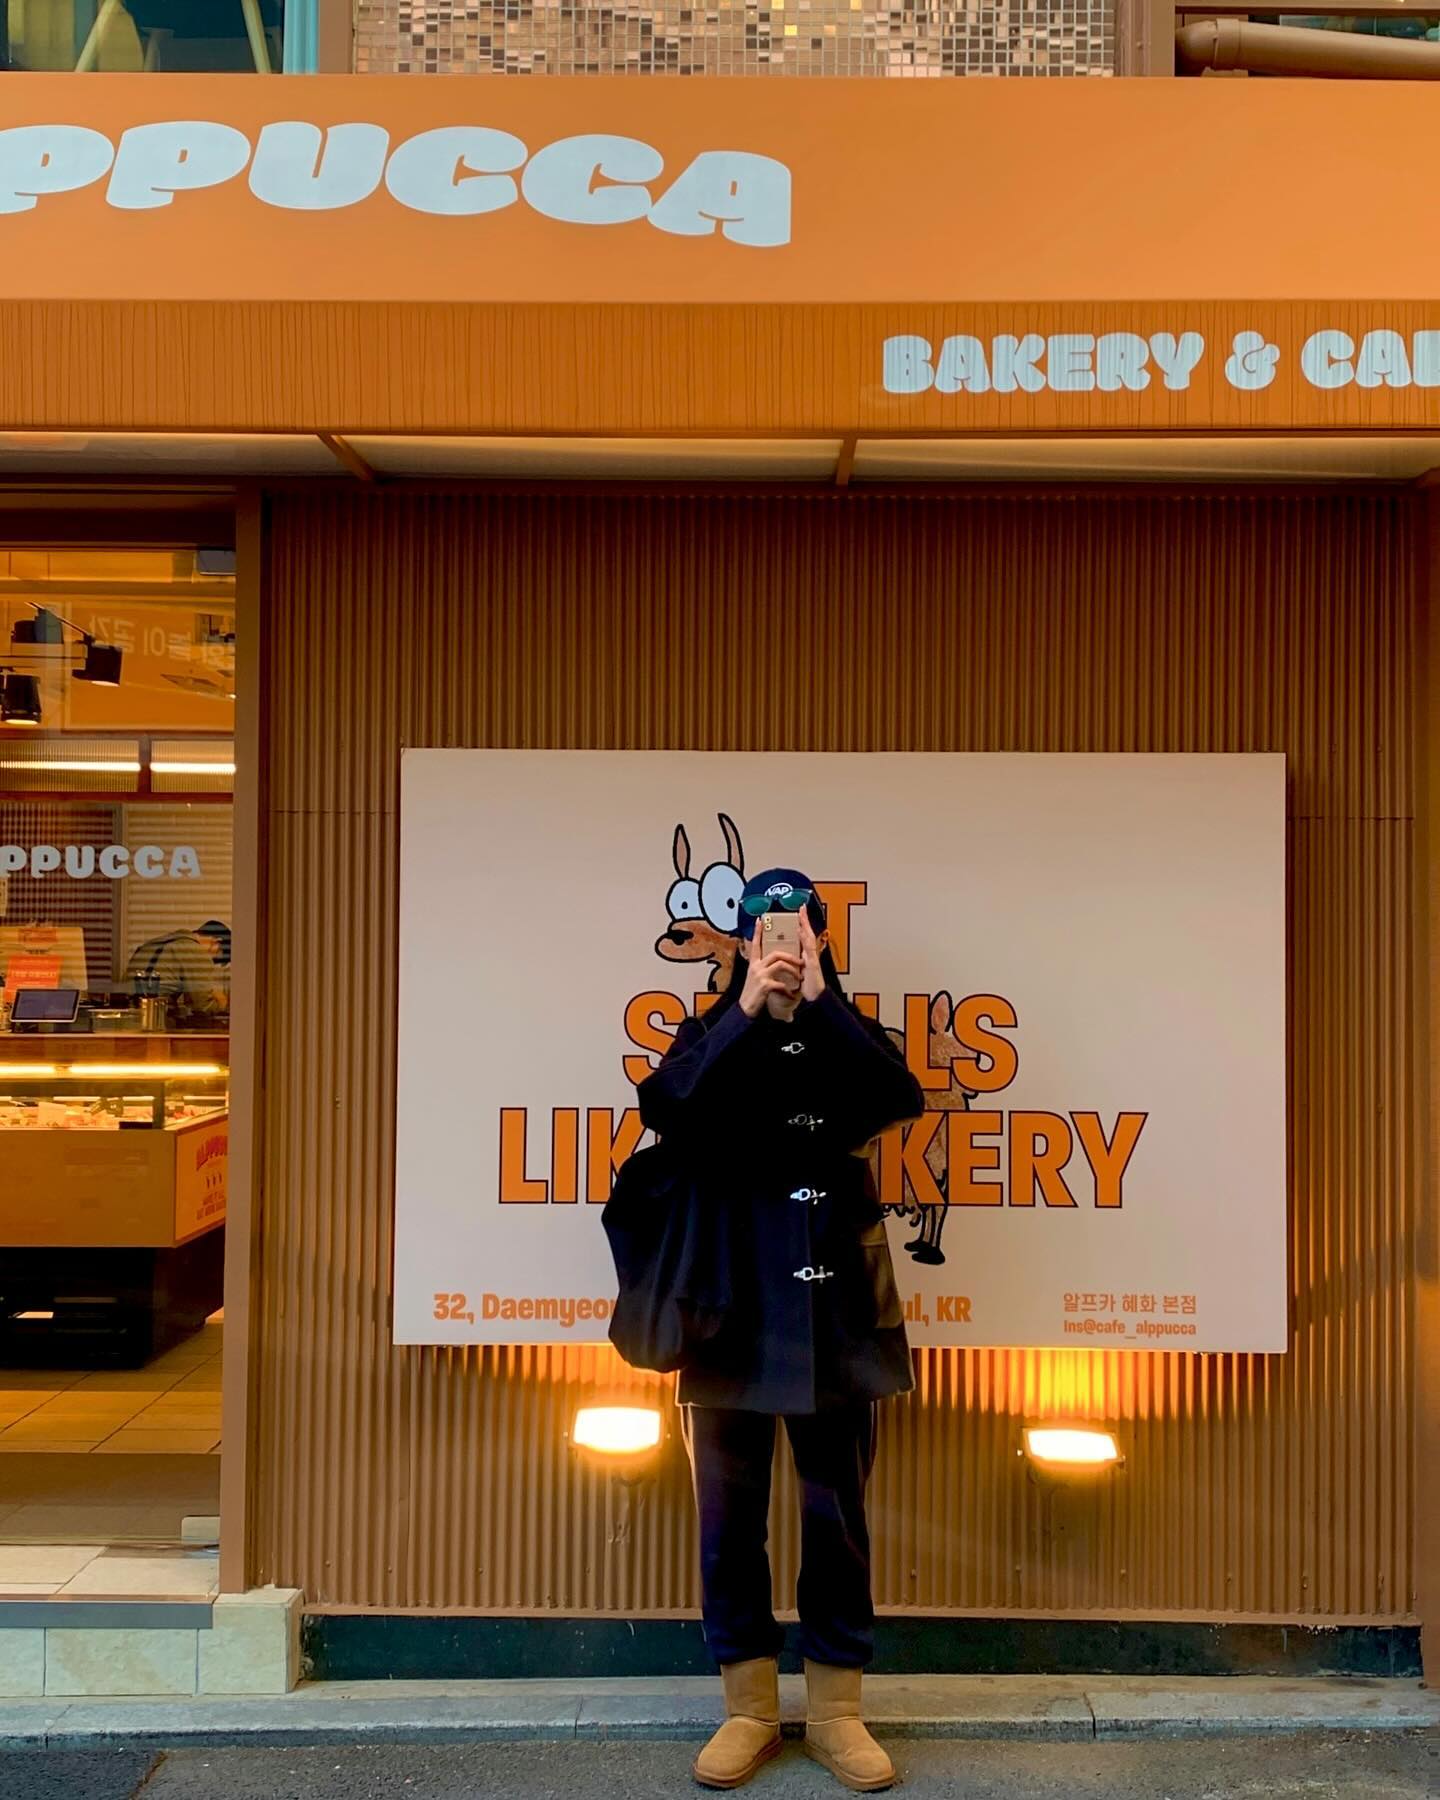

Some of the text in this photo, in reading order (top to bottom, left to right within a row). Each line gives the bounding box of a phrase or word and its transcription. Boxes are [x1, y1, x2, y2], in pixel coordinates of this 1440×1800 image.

[883, 331, 1204, 394] BAKERY
[1225, 331, 1280, 390] &
[811, 881, 867, 975] T
[499, 1107, 1149, 1208] LIK KERY
[434, 1293, 474, 1325] 32,
[482, 1293, 616, 1328] Daemyeo
[937, 1296, 972, 1322] KR
[1064, 1293, 1196, 1314] 알프카 혜화 본점
